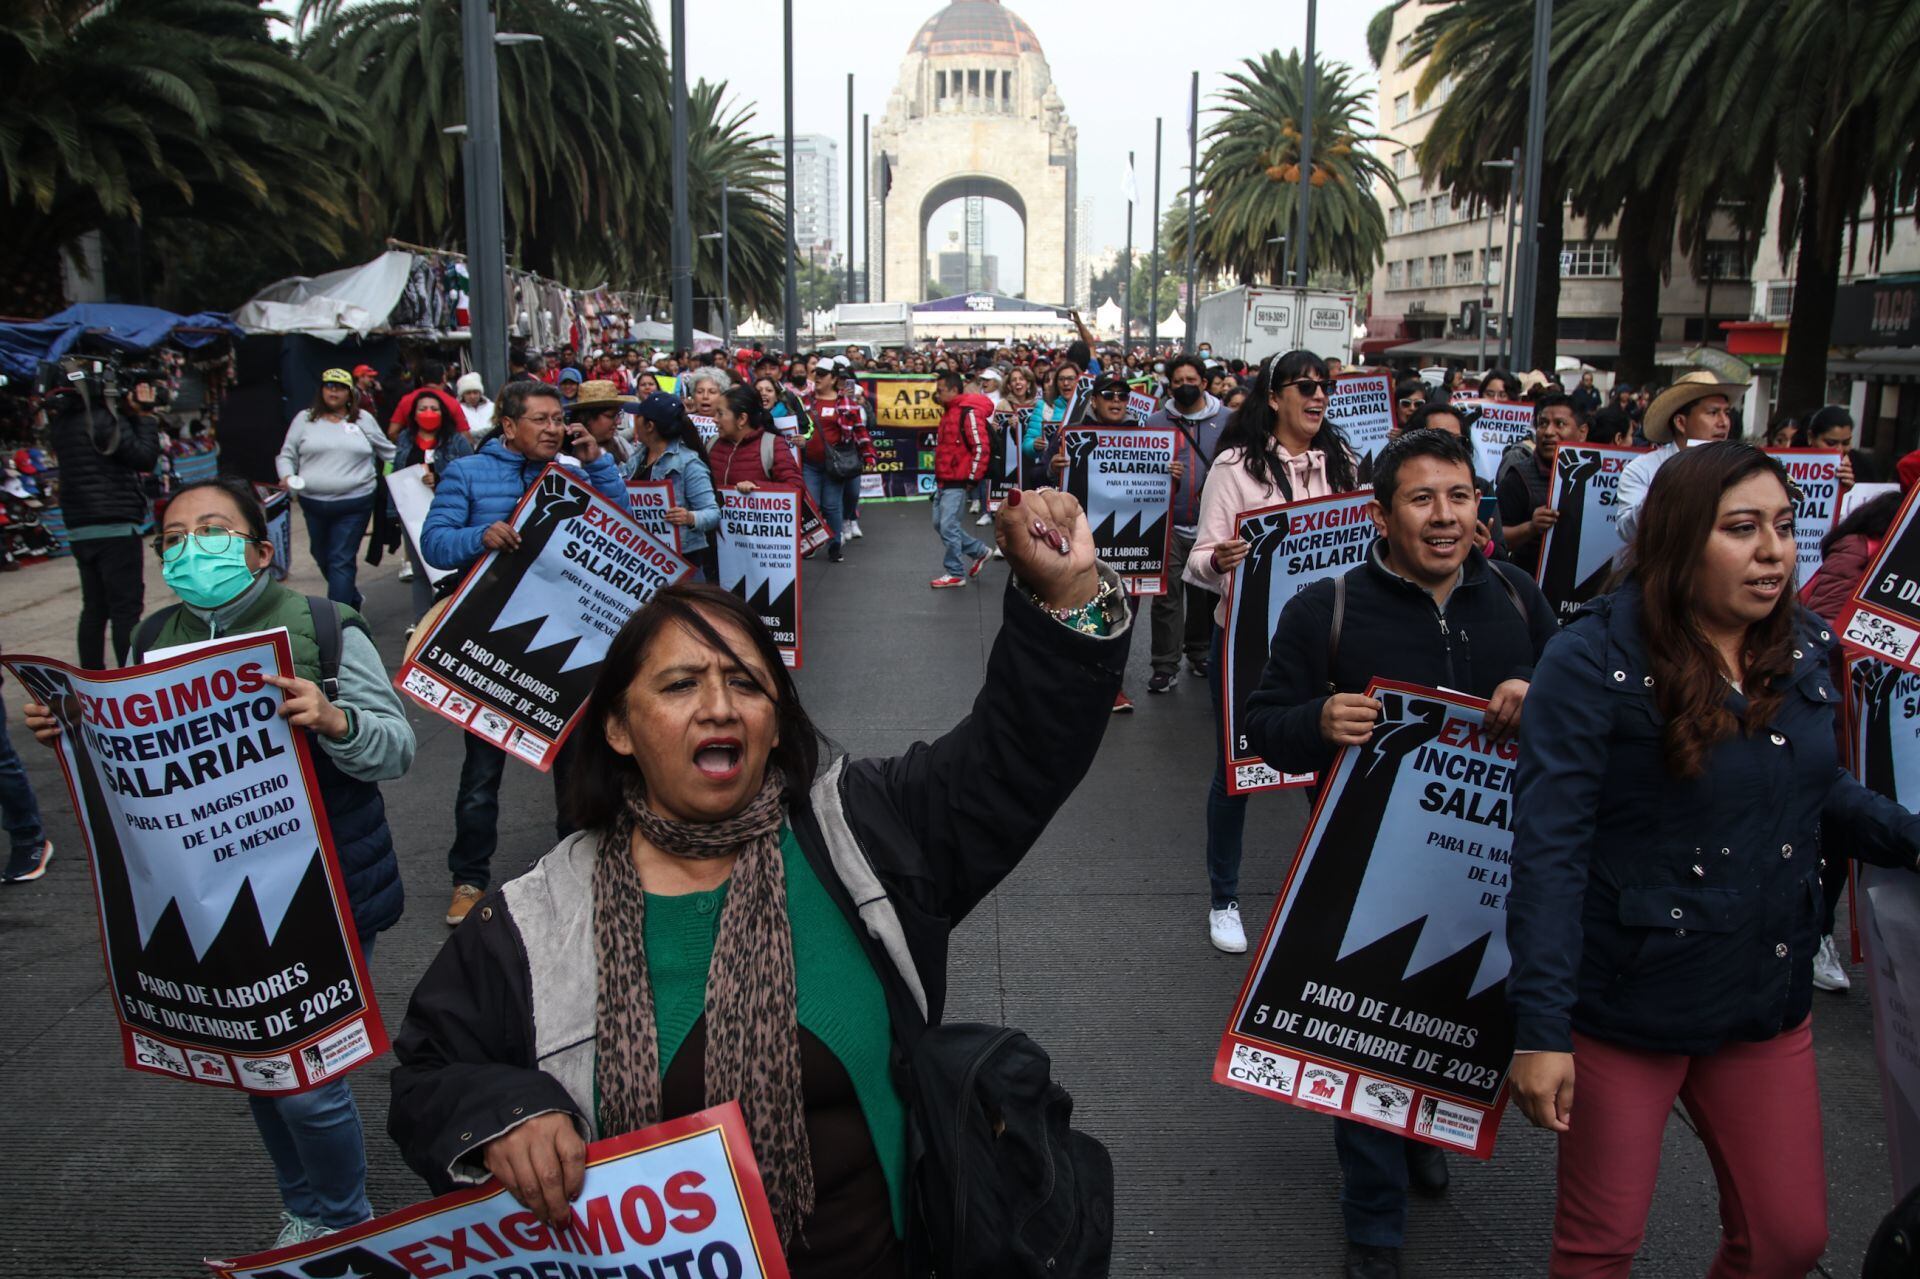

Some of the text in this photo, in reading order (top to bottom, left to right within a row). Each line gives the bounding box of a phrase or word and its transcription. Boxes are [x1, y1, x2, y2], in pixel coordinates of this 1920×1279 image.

[1327, 403, 1388, 419] SALARIAL
[1482, 408, 1531, 422] EXIGIM
[1476, 420, 1527, 433] INCREME
[1098, 436, 1170, 449] EXIGIMOS
[1093, 450, 1170, 462] INCREMENTO
[1100, 462, 1169, 474] SALARIAL
[724, 496, 791, 510] EXIGIMOS
[721, 509, 793, 523] INCREMENTO
[1290, 504, 1367, 536] EXIGIM
[582, 504, 678, 575] EXIGIMOS
[727, 523, 793, 538] SALARIAL
[564, 519, 668, 588] INCREMENTO
[1102, 548, 1112, 557] DE
[1115, 547, 1149, 557] LABORES
[563, 541, 654, 603] SALARIAL
[1129, 561, 1139, 570] DE
[1141, 561, 1161, 570] 2023
[561, 570, 582, 586] PARA
[582, 583, 592, 592] EL
[1880, 573, 1899, 594] 5
[578, 596, 591, 608] DE
[591, 601, 600, 614] LA
[581, 612, 618, 638] DE MÉXIC
[774, 631, 794, 642] 2023
[1847, 629, 1904, 658] CNTE
[460, 639, 560, 704] PARO DE LABORES
[75, 661, 267, 730] EXIGIMOS
[405, 681, 439, 706] CNTE
[428, 645, 564, 732] 5 DE DICIEMBRE DE 2023
[87, 696, 277, 762] INCREMENTO
[1438, 717, 1519, 762] EXIG
[1239, 735, 1248, 750] 5
[103, 728, 285, 798] SALARIAL
[1238, 777, 1279, 788] CNTE
[127, 774, 289, 833] PARA EL MAGISTERIO
[1420, 782, 1510, 832] SALA
[183, 796, 295, 850] DE LA CIUDAD
[213, 817, 301, 863] DE MÉXICO
[1426, 831, 1465, 855] PARA
[1467, 843, 1484, 860] EL
[1468, 865, 1507, 888] DE LA
[1480, 891, 1501, 906] DE
[137, 962, 310, 1009] PARO DE LABORES
[125, 979, 354, 1041] 5 DE DICIEMBRE DE 2023
[1300, 981, 1479, 1049] PARO DE LABORES
[1253, 1004, 1500, 1091] 5 DE DICIEMBRE DE 2023
[138, 1053, 188, 1074] CNTE
[1230, 1067, 1291, 1092] CNTE
